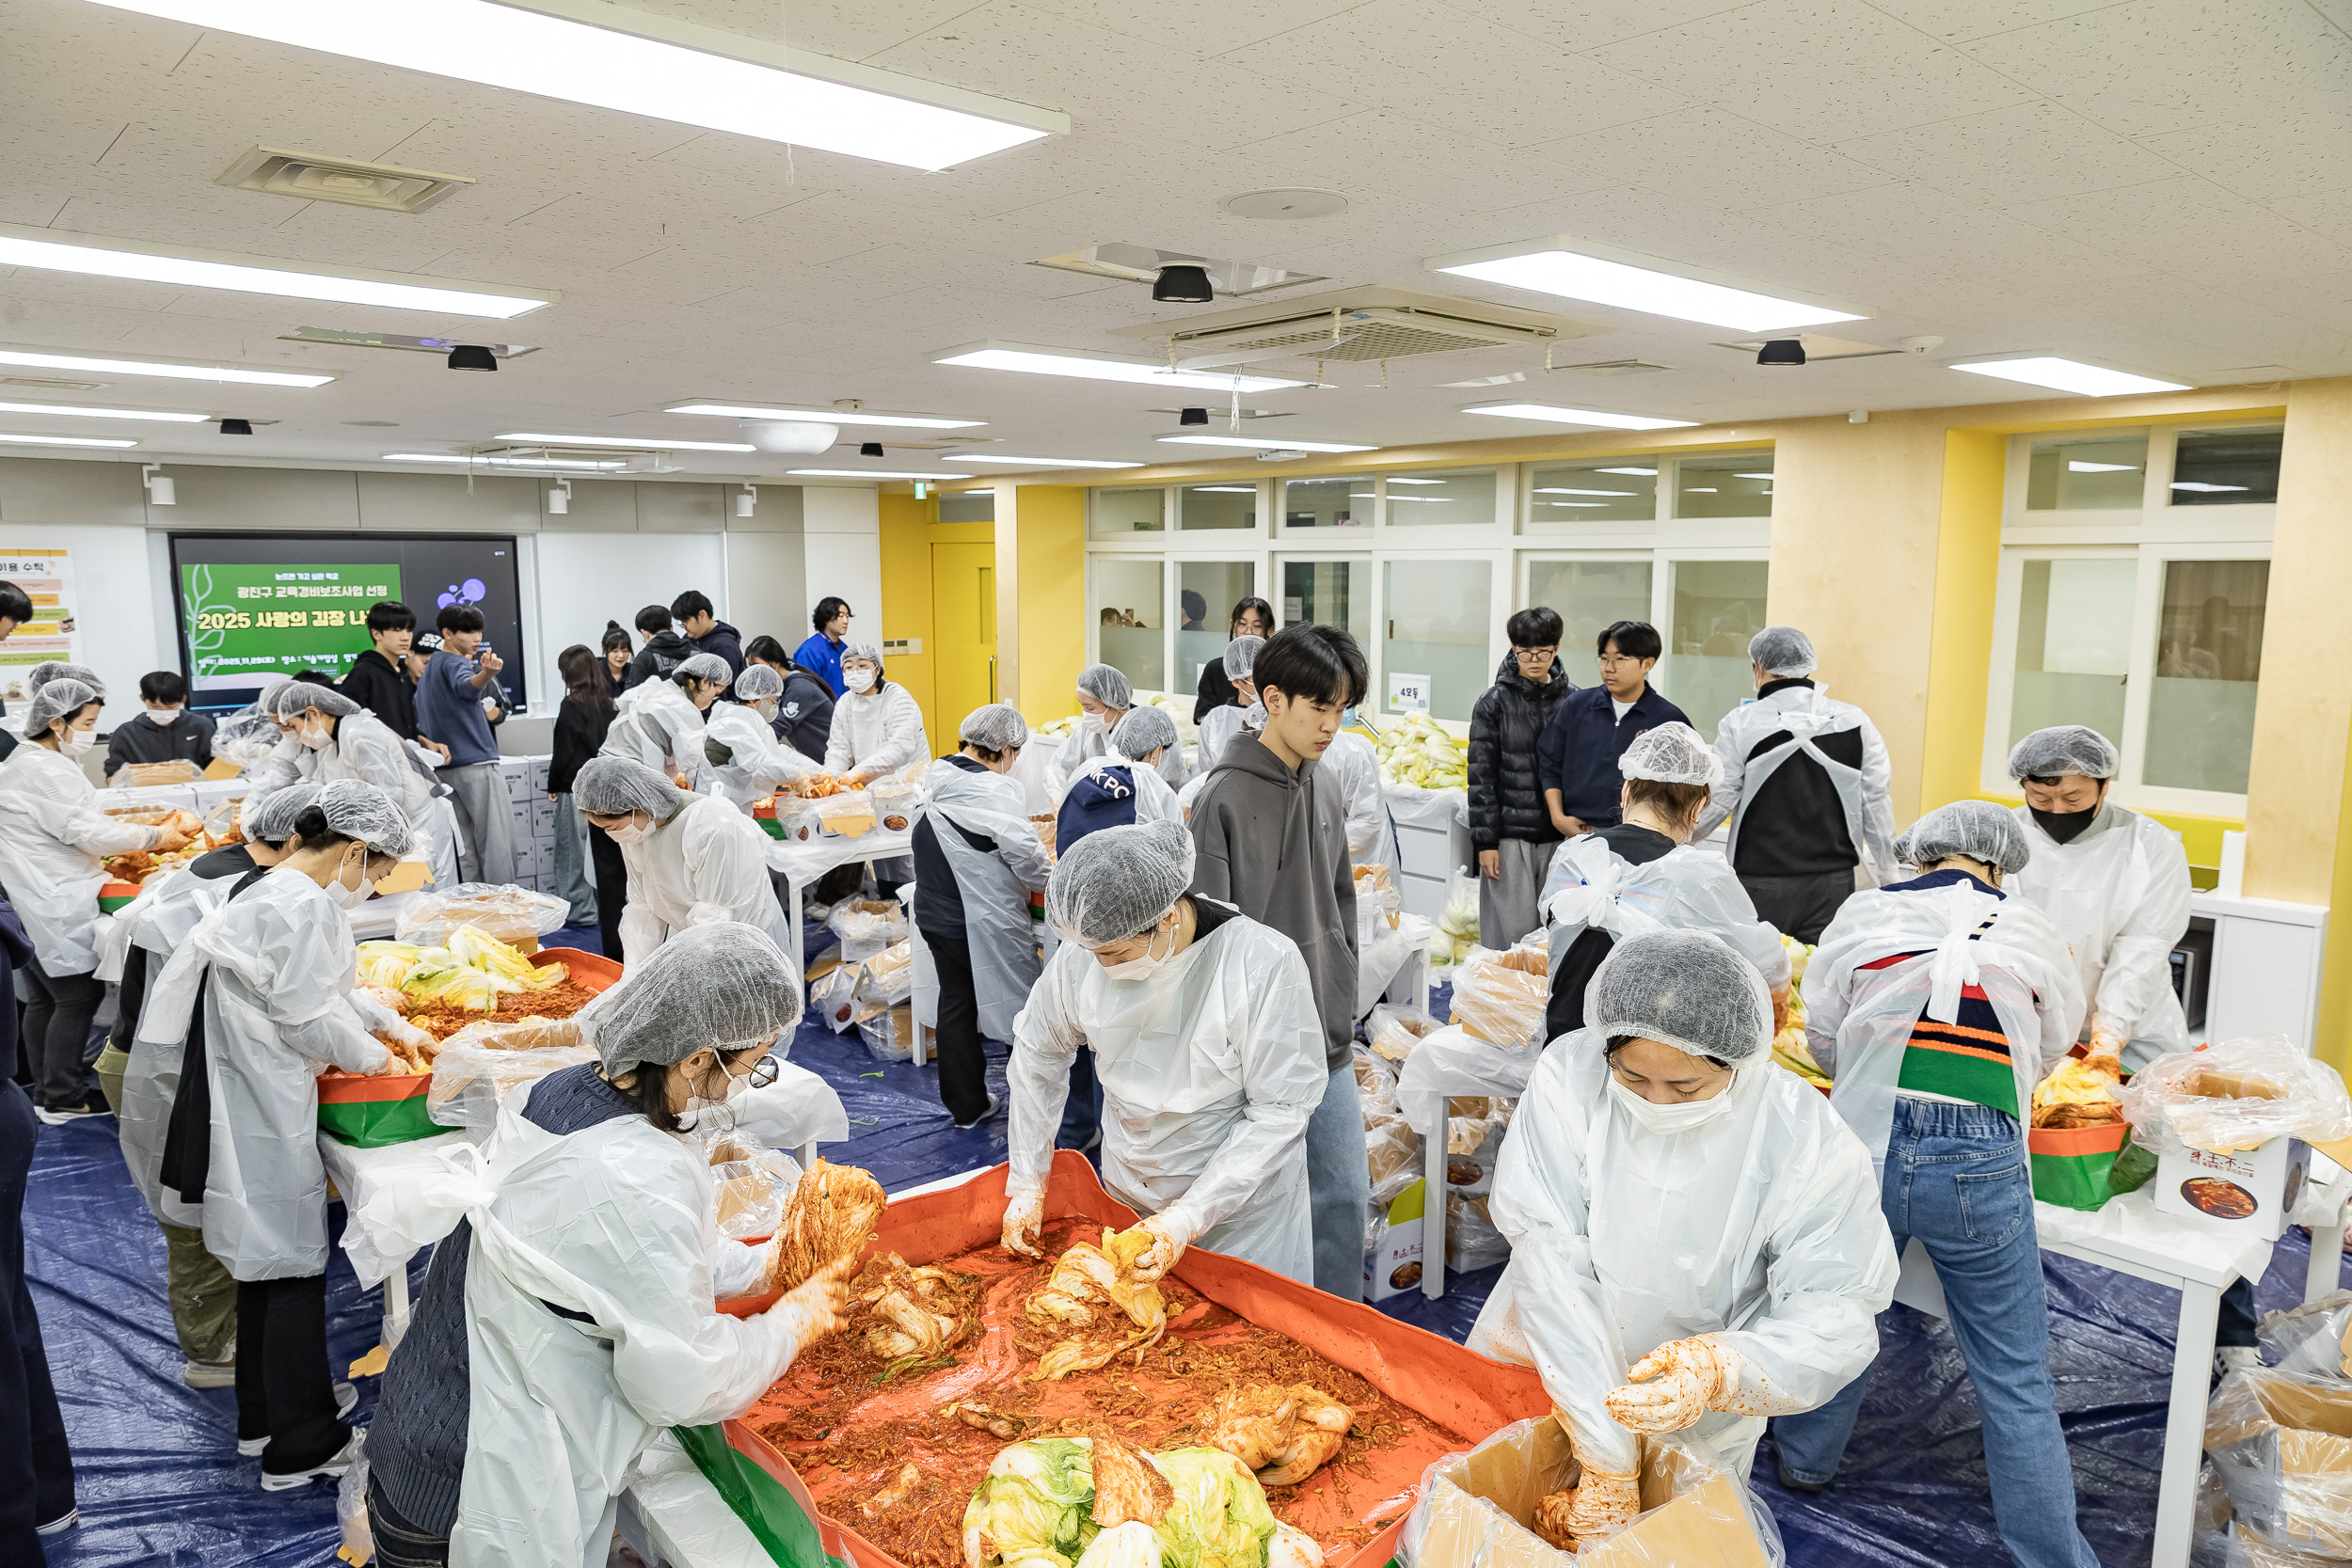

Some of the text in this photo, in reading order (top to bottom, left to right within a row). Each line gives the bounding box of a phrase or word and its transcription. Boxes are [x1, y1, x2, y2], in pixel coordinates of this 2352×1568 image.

[237, 584, 388, 599] 광진구 교육경비보조사업 선정
[198, 610, 370, 630] 2025 사랑의 김장 나
